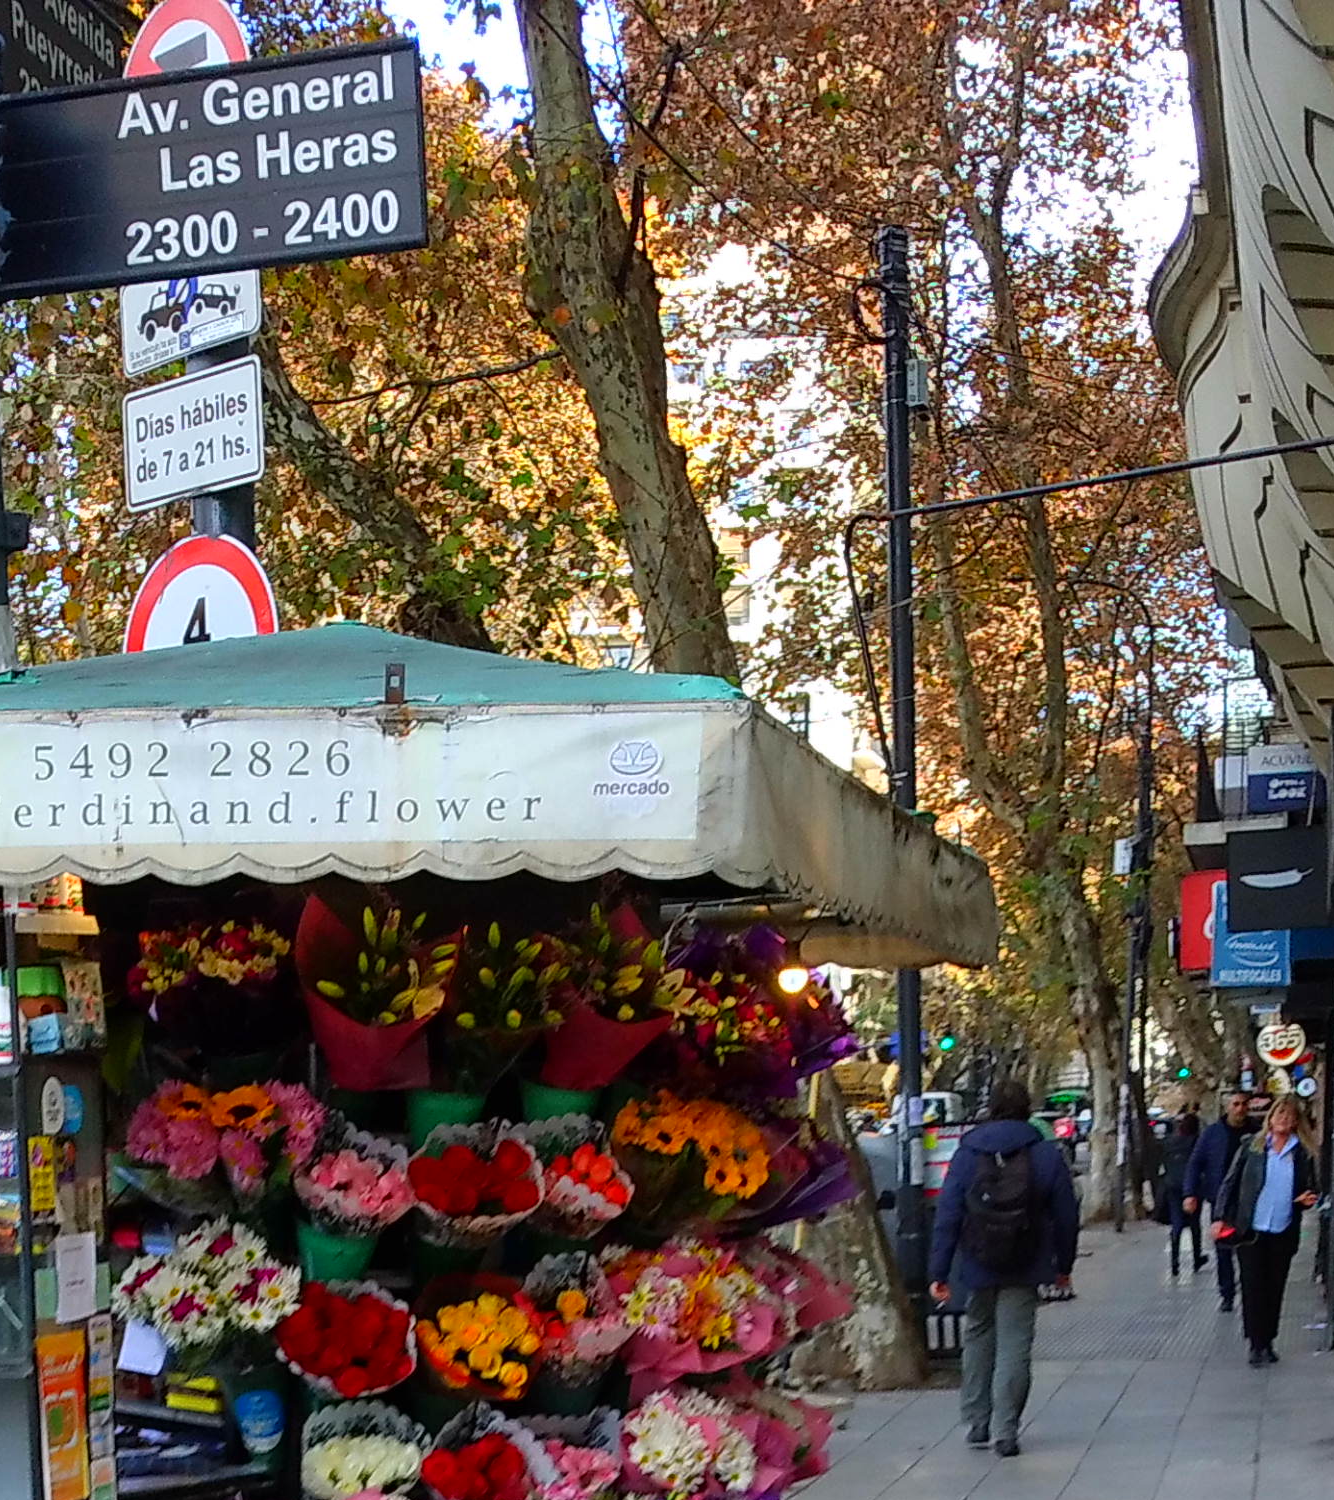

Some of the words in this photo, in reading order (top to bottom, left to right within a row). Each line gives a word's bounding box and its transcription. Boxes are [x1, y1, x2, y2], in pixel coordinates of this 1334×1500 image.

[11, 0, 103, 85] Pueyrred
[44, 0, 115, 68] Avenida
[117, 91, 189, 139] Av.
[202, 55, 394, 126] General
[160, 146, 241, 192] Las
[255, 128, 398, 179] Heras
[126, 210, 238, 266] 2300
[283, 189, 399, 245] 2400
[135, 412, 174, 442] Días
[180, 392, 248, 430] hábiles
[136, 458, 157, 483] de
[162, 450, 173, 476] 7
[179, 456, 190, 472] a
[195, 441, 214, 469] 21
[222, 434, 251, 461] hs.
[182, 596, 212, 646] 4
[34, 741, 170, 782] 5492
[209, 739, 351, 778] 2826
[593, 778, 670, 797] mercado
[1259, 1027, 1303, 1053] 365
